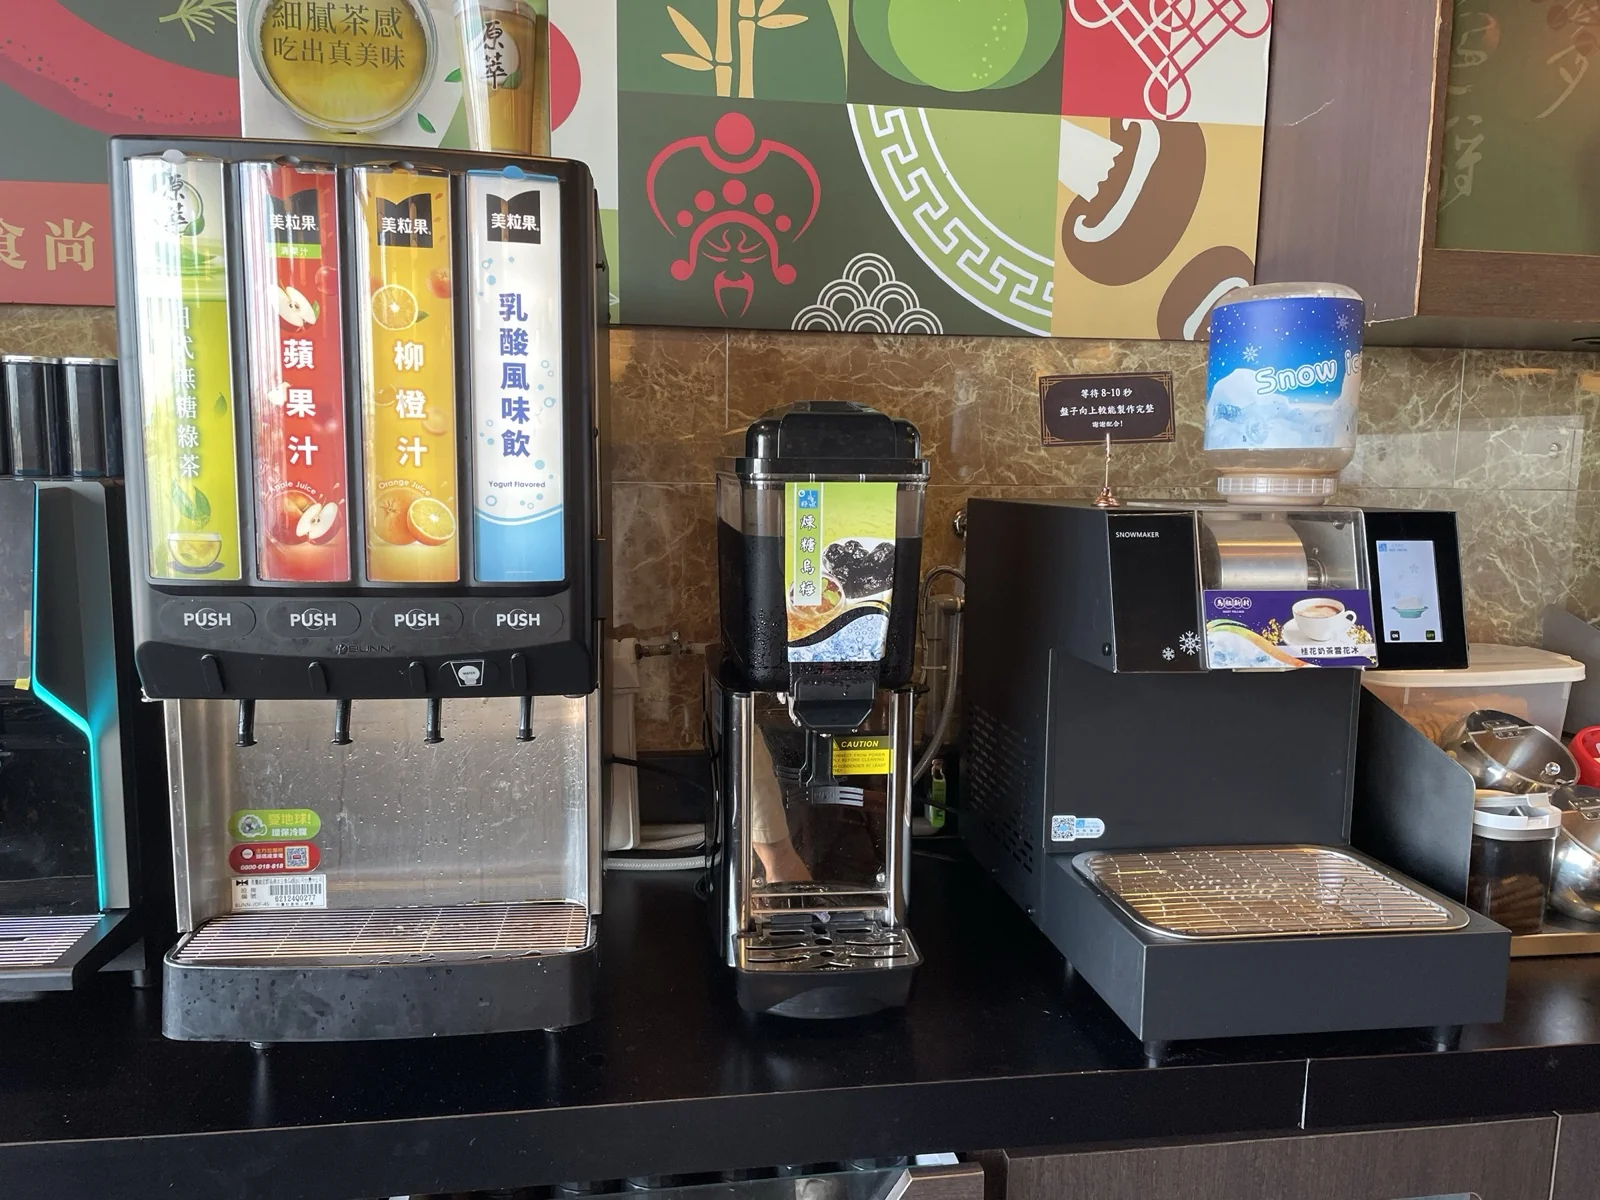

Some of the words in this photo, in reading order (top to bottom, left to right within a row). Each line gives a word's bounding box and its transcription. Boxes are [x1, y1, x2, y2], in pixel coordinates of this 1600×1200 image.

[272, 1, 403, 39] 細膩茶感
[273, 36, 405, 70] 吃出真美味
[270, 213, 316, 231] 美粒果
[381, 216, 429, 236] 美粒果
[491, 213, 538, 231] 美粒果
[498, 293, 531, 458] 乳酸風味飲
[1254, 359, 1338, 395] Snow
[1080, 388, 1100, 399] 等待
[1122, 388, 1133, 398] 秒
[283, 338, 319, 466] 蘋果汁
[394, 341, 428, 467] 柳橙汁
[1060, 403, 1155, 416] 盤子向上較能製作完整
[295, 480, 317, 495] Juice
[378, 478, 410, 490] Orange
[411, 480, 431, 496] Juice
[488, 480, 512, 489] Yogurt
[514, 480, 546, 488] Flavored
[183, 612, 231, 627] PUSH
[290, 613, 337, 627] PUSH
[394, 613, 440, 627] PUSH
[496, 613, 541, 627] PUSH
[349, 645, 391, 653] BUNN
[841, 740, 879, 748] CAUTION
